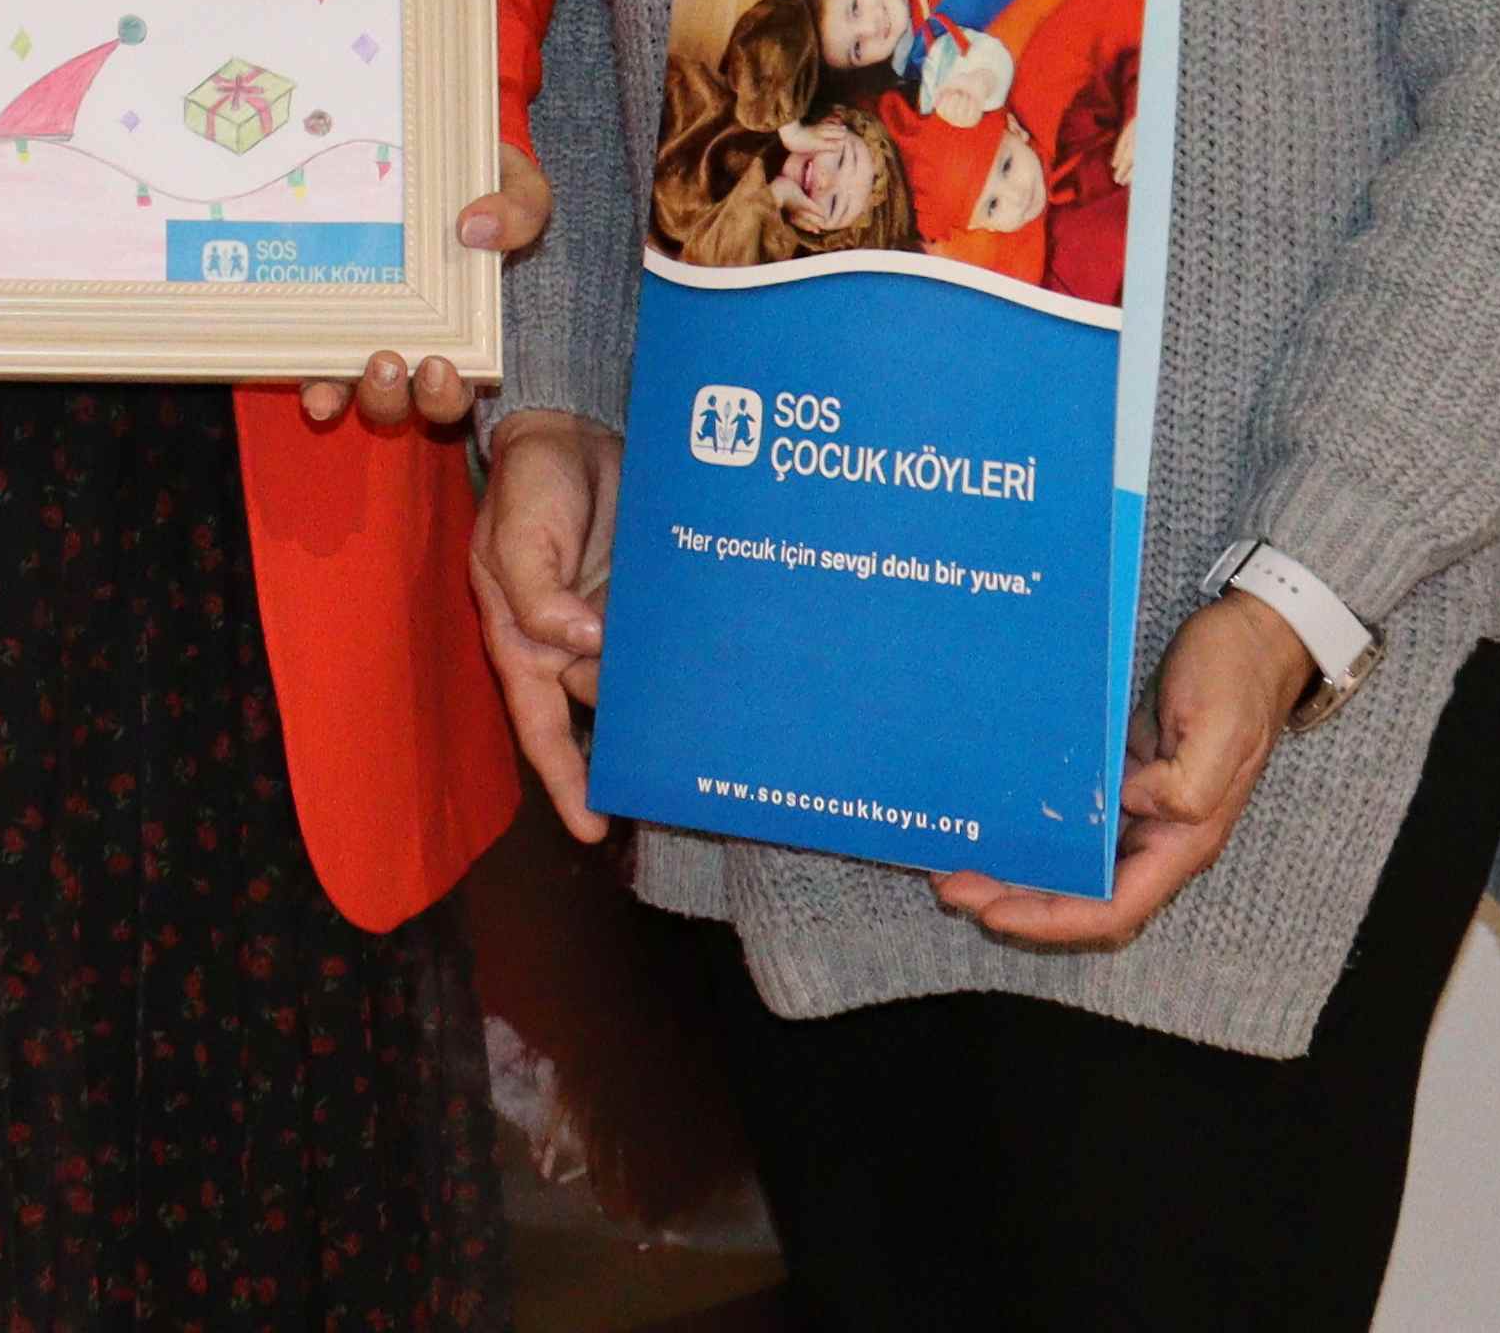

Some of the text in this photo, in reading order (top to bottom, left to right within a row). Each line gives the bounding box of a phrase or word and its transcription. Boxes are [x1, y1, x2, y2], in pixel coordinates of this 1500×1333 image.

[255, 239, 298, 262] SOS
[773, 391, 841, 432] SOS
[770, 436, 1037, 502] ÇOCUK KÖYLERİ
[715, 535, 777, 562] çocuk
[780, 539, 816, 571] için
[820, 548, 878, 580] sevgi
[881, 553, 930, 583] dolu
[934, 558, 965, 586] bir
[697, 776, 980, 841] www.soscocukkoyu.org
